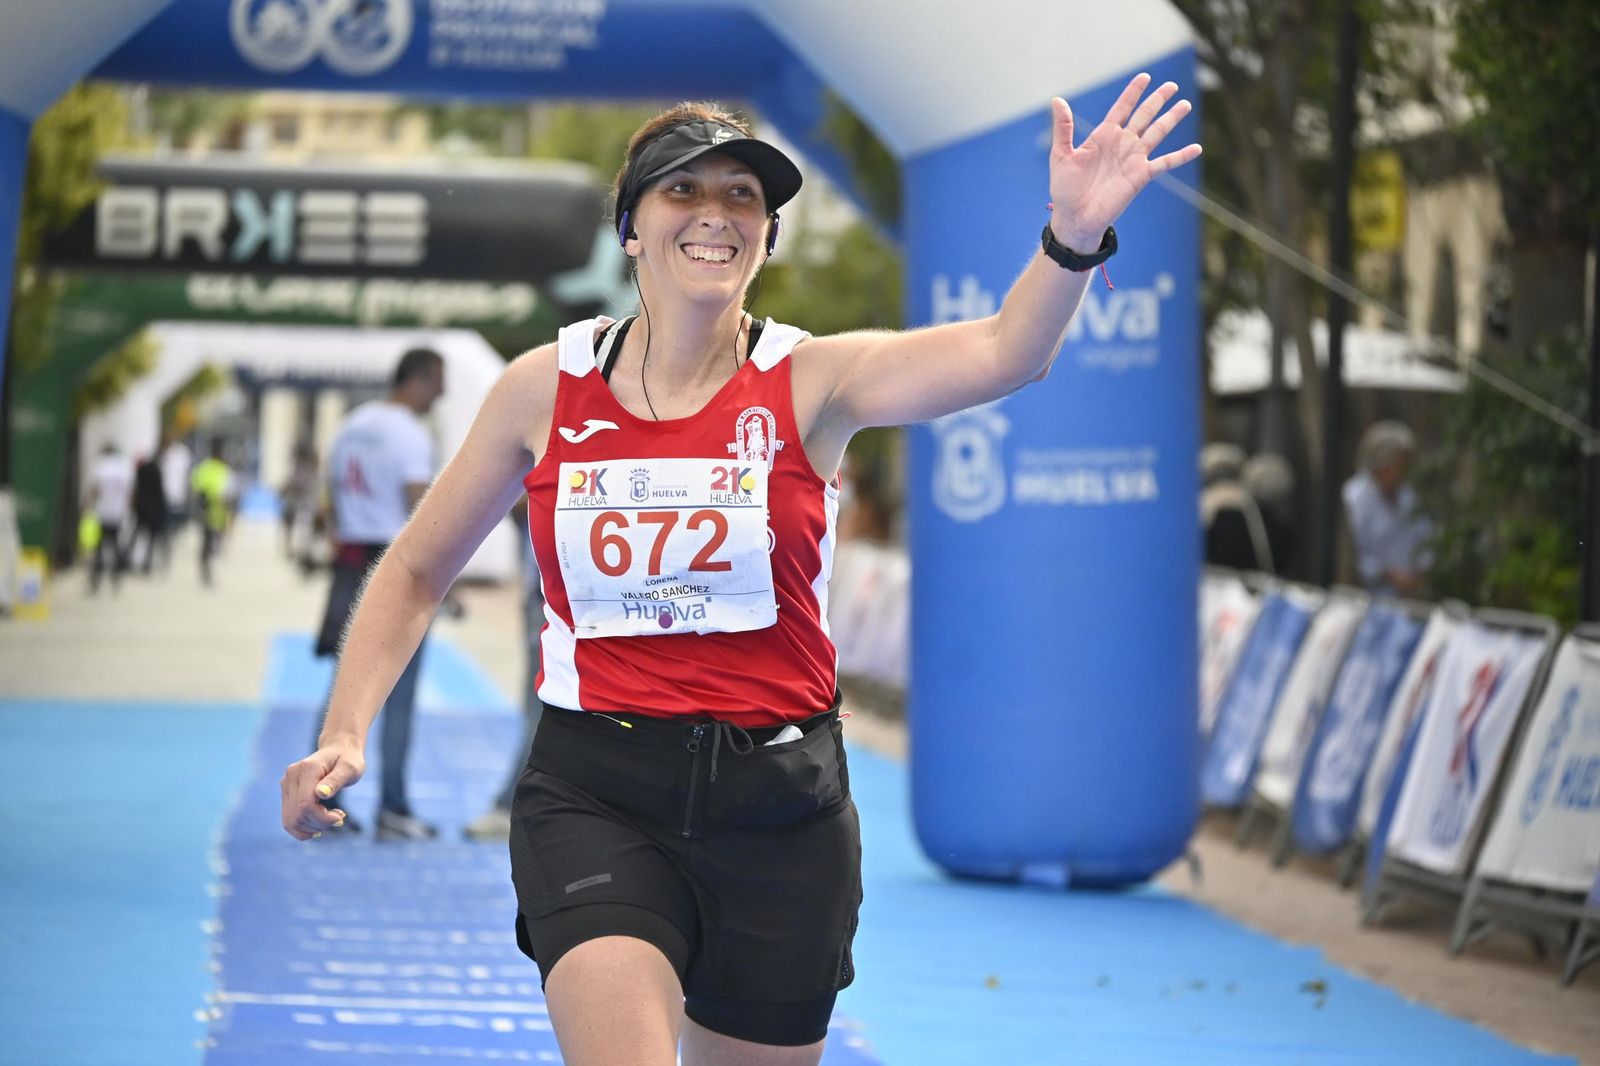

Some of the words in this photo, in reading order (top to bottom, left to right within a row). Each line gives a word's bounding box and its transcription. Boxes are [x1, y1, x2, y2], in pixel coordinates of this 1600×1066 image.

[710, 466, 752, 495] 21K
[652, 490, 688, 498] HUELVA
[710, 493, 752, 505] HUELVA
[568, 496, 608, 507] HUELVA
[589, 509, 732, 577] 672
[645, 576, 679, 587] LORENA
[621, 590, 660, 601] VALERO
[662, 584, 710, 599] SANCHEZ
[622, 602, 707, 622] Huelva
